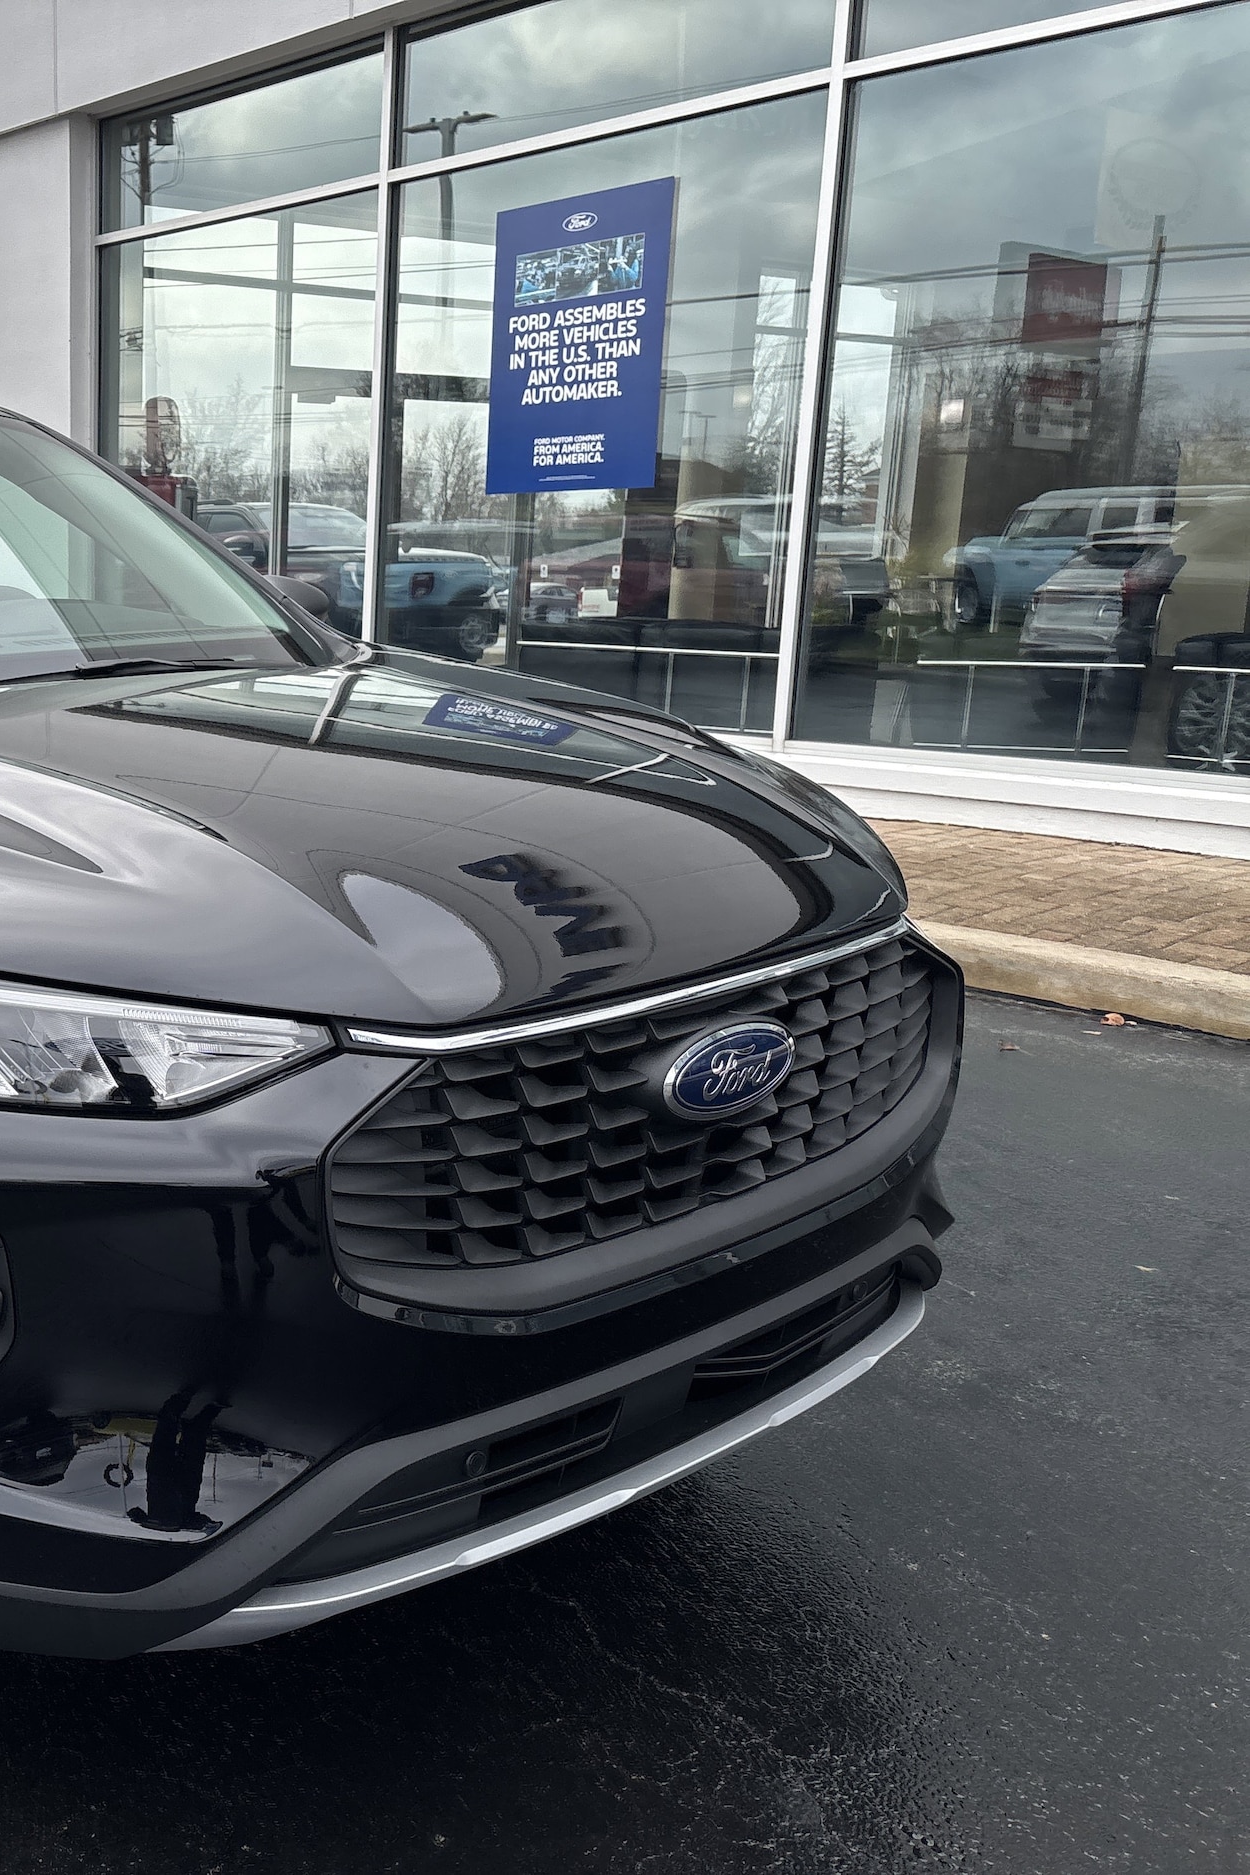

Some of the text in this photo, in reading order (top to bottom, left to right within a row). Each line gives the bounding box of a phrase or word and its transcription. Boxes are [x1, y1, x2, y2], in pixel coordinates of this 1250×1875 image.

[508, 298, 646, 334] FORD ASSEMBLES
[514, 319, 637, 351] MORE VEHICLES
[509, 338, 641, 370] IN THE U.S. THAN
[527, 360, 618, 386] ANY OTHER
[521, 379, 623, 405] AUTOMAKER.
[533, 433, 606, 445] FORD MOTOR COMPANY.
[533, 441, 605, 455] FROM AMERICA.
[533, 452, 605, 467] FOR AMERICA.
[702, 1043, 773, 1101] Ford
